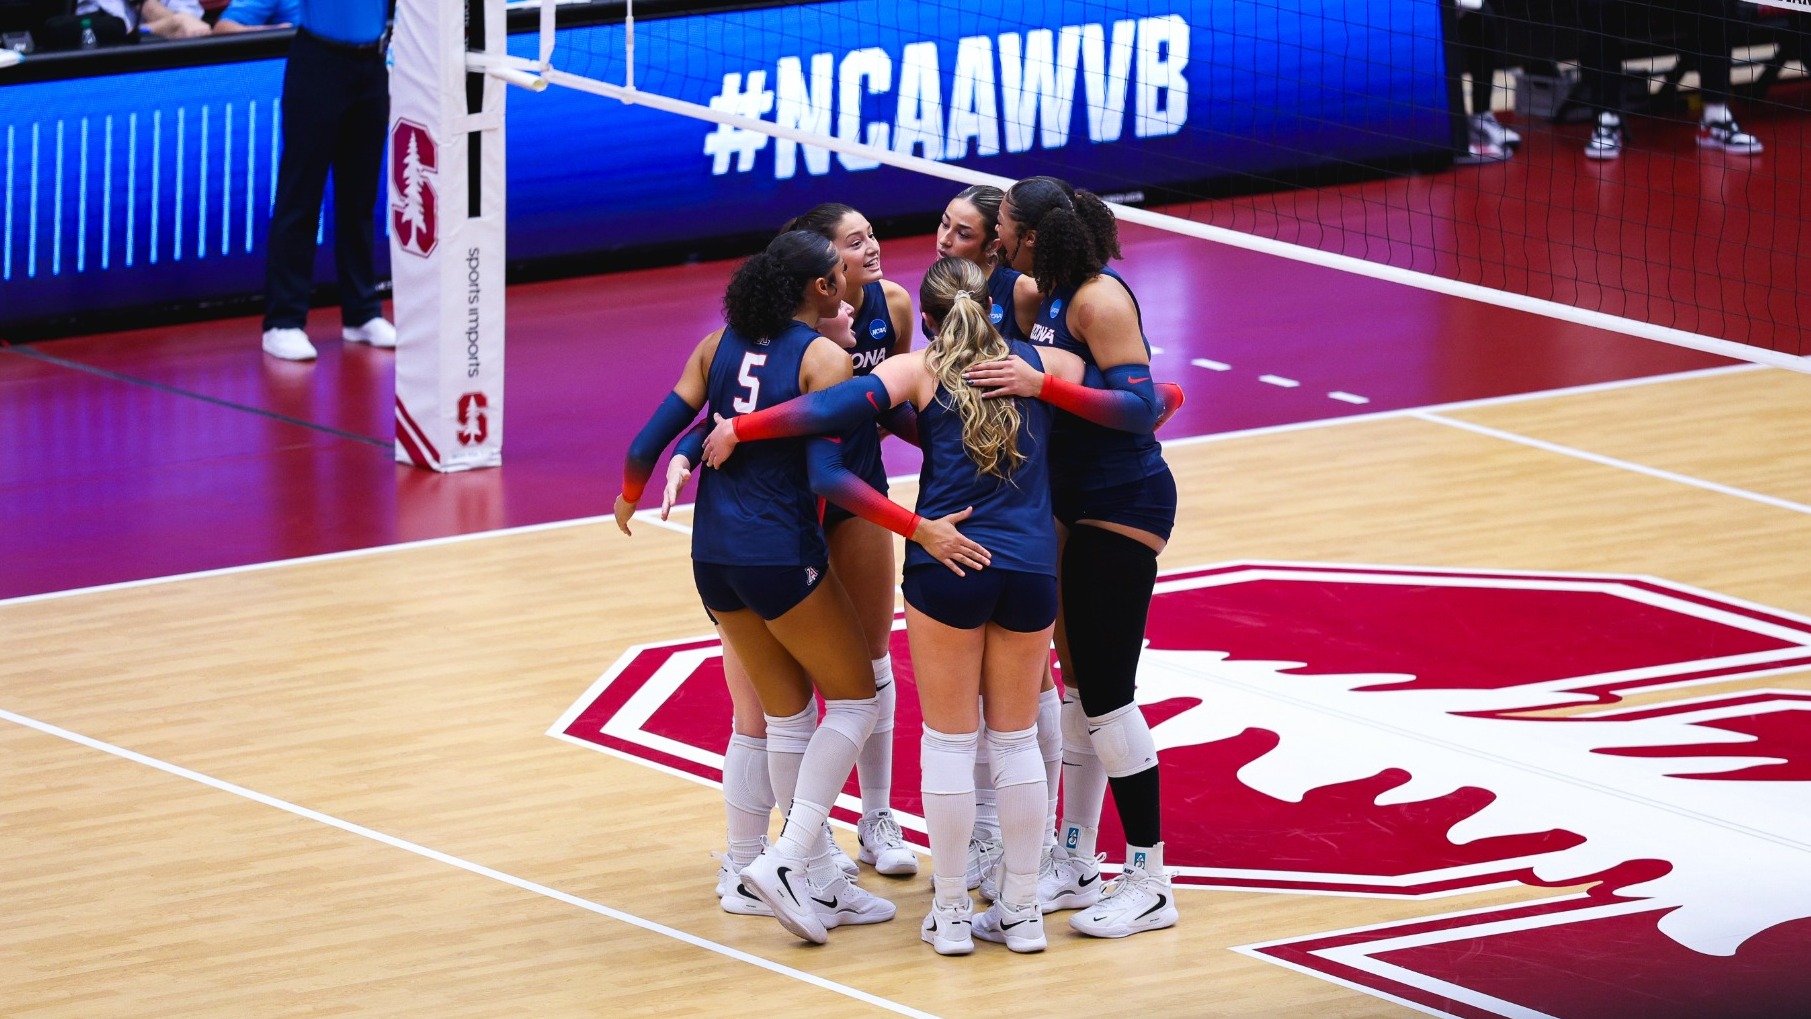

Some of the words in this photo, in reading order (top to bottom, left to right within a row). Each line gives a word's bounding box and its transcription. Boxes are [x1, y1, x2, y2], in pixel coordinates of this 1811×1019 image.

[704, 14, 1190, 179] #NCAAWVB
[466, 247, 481, 304] sports
[465, 307, 480, 378] imports
[733, 352, 767, 414] 5
